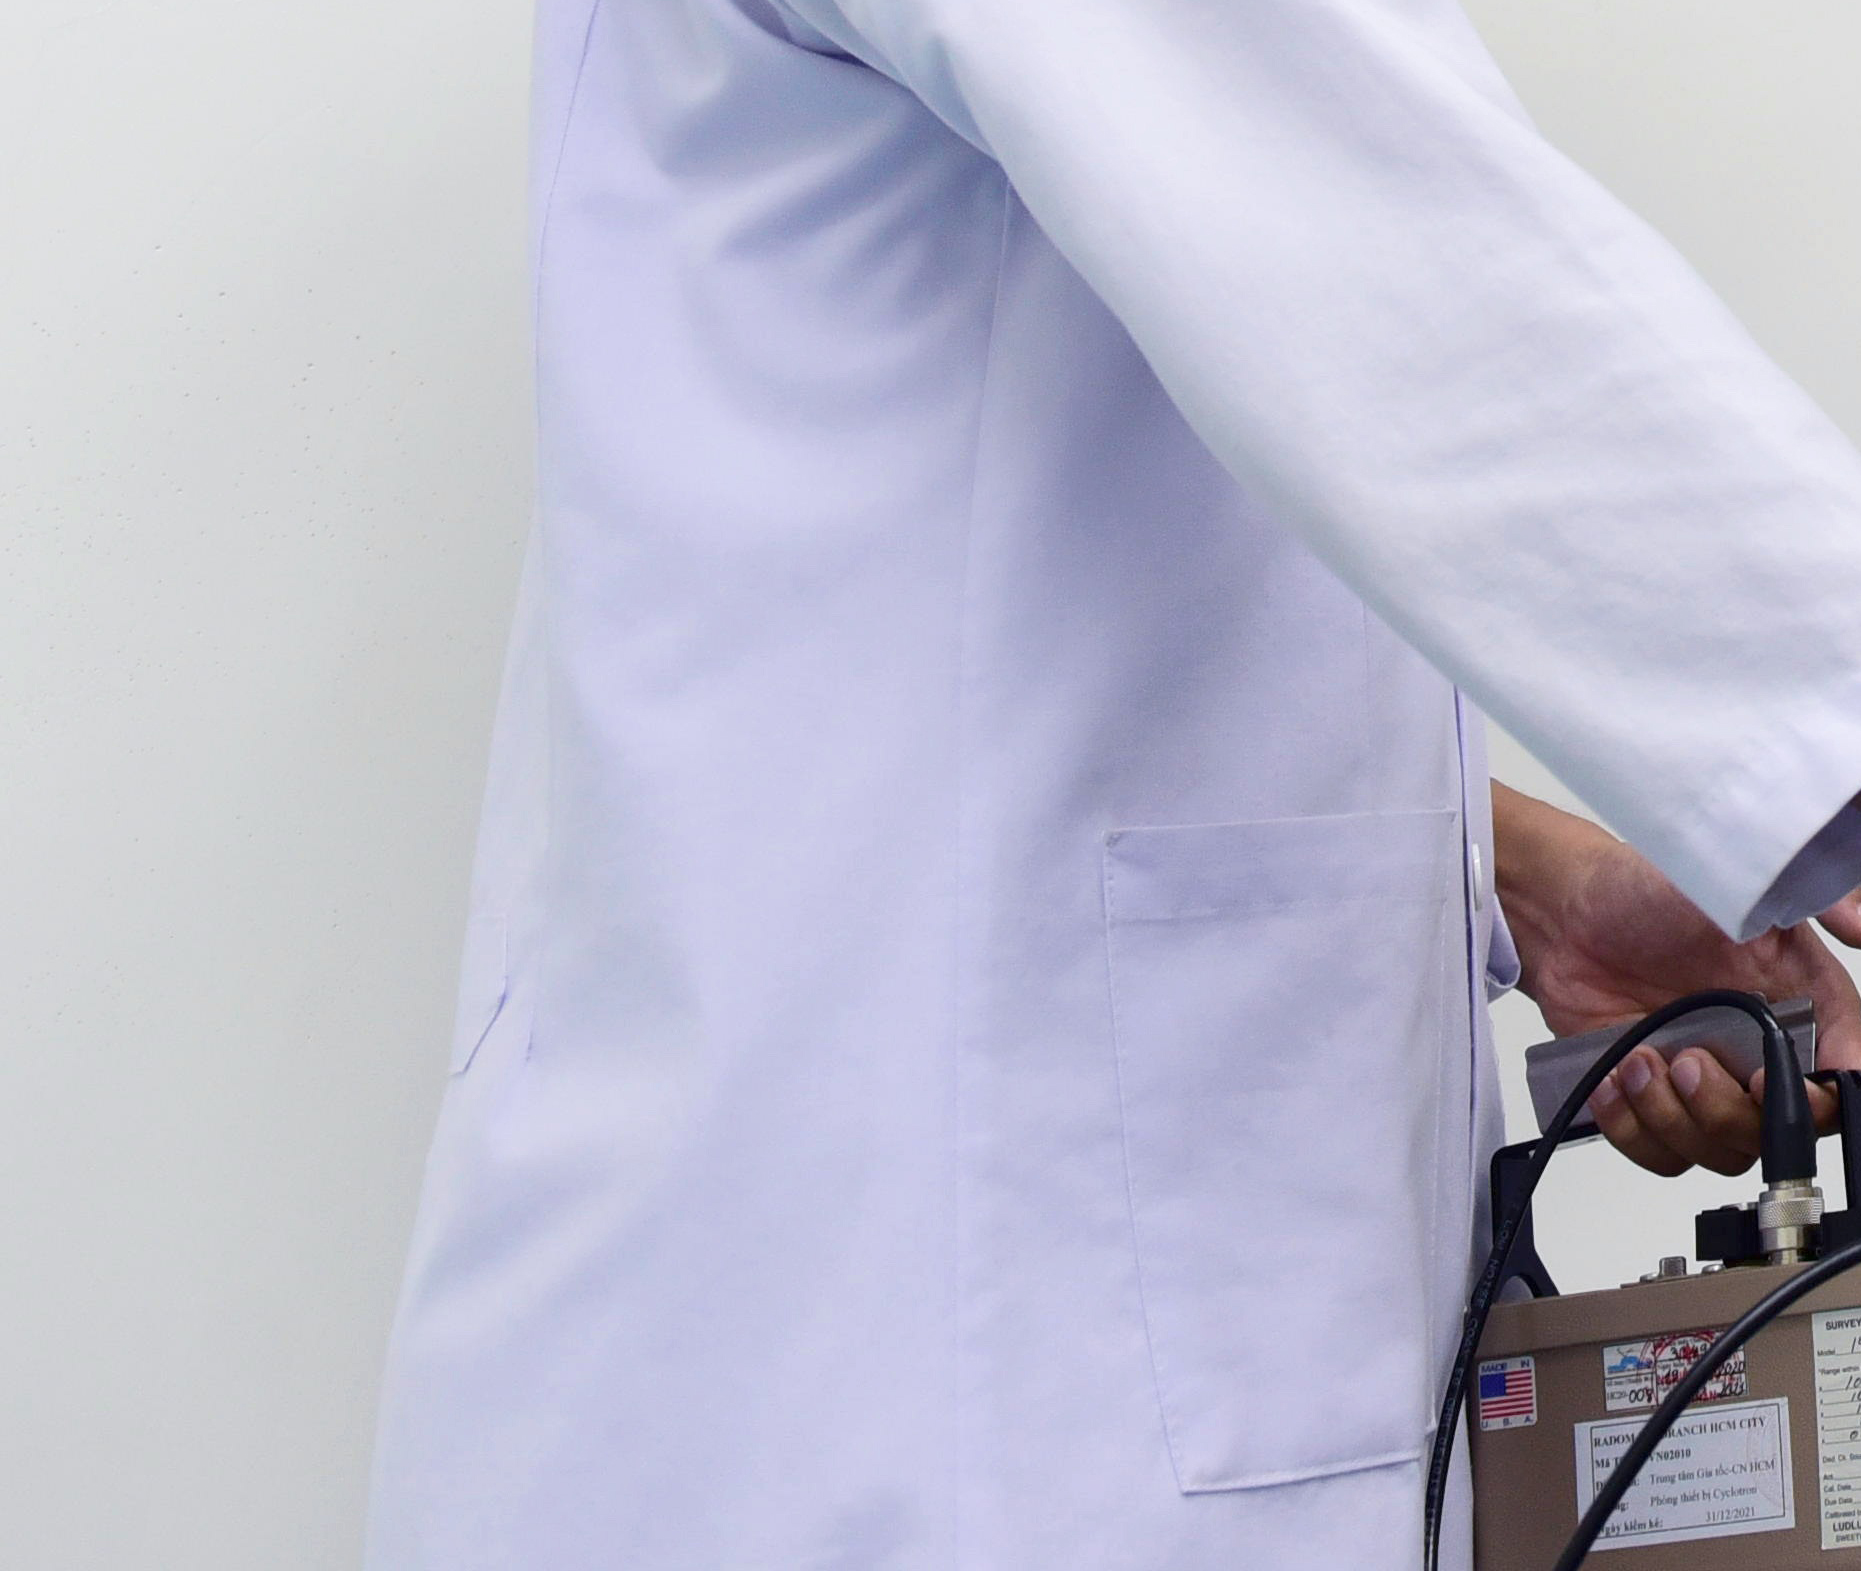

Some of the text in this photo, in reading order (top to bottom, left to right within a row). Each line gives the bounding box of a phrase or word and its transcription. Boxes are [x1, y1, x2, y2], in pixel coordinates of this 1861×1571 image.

[1825, 1319, 1861, 1331] SURVEY
[1481, 1359, 1530, 1372] MADE IN
[1710, 1420, 1736, 1433] HCM
[1739, 1416, 1765, 1428] CITY
[1650, 1474, 1676, 1485] Trung
[1678, 1470, 1694, 1481] tâm
[1697, 1467, 1712, 1478] Gia
[1749, 1459, 1775, 1473] HCM
[1713, 1486, 1757, 1501] Cyclotron
[1824, 1498, 1837, 1507] Due
[1705, 1506, 1755, 1523] 31/12/2021
